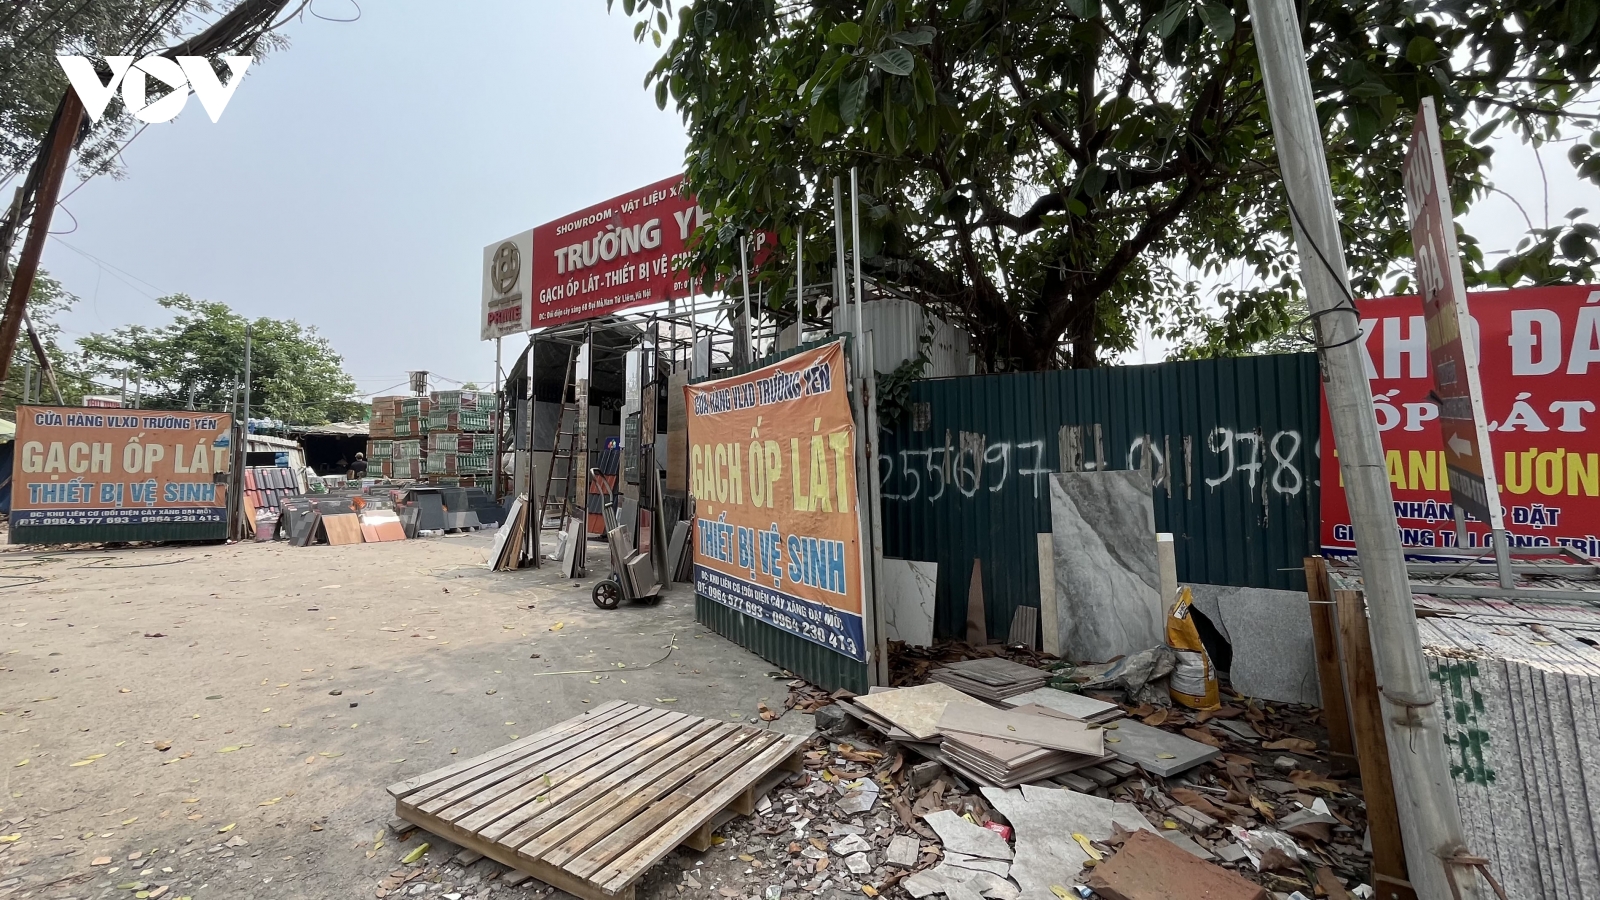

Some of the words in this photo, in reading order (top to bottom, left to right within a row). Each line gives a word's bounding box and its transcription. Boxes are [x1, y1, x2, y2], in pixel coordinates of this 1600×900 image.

[556, 208, 612, 236] SHOWROOM
[621, 199, 641, 215] VẬT
[643, 189, 667, 206] LIỆU
[554, 218, 662, 274] TRƯỜNG
[540, 284, 564, 305] GẠCH
[566, 277, 580, 297] ỐP
[582, 273, 600, 294] LÁT
[605, 261, 635, 286] THIẾT
[639, 262, 649, 282] BỊ
[653, 254, 668, 278] VỆ
[488, 305, 522, 326] PRIME
[694, 390, 709, 416] CỬA
[709, 386, 730, 414] HÀNG
[732, 381, 756, 410] VLXD
[756, 368, 802, 406] TRƯỜNG
[35, 411, 63, 428] CỬA
[66, 412, 103, 428] HÀNG
[107, 415, 139, 429] VLXD
[142, 414, 190, 430] TRƯỜNG
[22, 441, 112, 480] GẠCH
[123, 433, 164, 474] ỐP
[174, 438, 229, 474] LÁT
[693, 442, 743, 514] GẠCH
[748, 416, 782, 509] ỐP
[791, 417, 850, 513] LÁT
[27, 476, 94, 504] THIẾT
[100, 483, 124, 507] BỊ
[130, 479, 158, 506] VỆ
[164, 483, 216, 503] SINH
[1512, 504, 1560, 529] ĐẶT
[697, 510, 735, 565] THIẾT
[738, 525, 757, 580] BỊ
[759, 521, 783, 588] VỆ
[788, 534, 847, 596] SINH
[709, 573, 720, 585] KHU
[720, 577, 732, 590] LIÊN
[770, 594, 785, 610] CÂY
[786, 600, 807, 618] XĂNG
[708, 586, 727, 604] 0964
[728, 594, 743, 610] 577
[745, 601, 763, 618] 693
[772, 611, 799, 632] 0964
[802, 621, 826, 643] 230
[829, 631, 857, 655] 413
